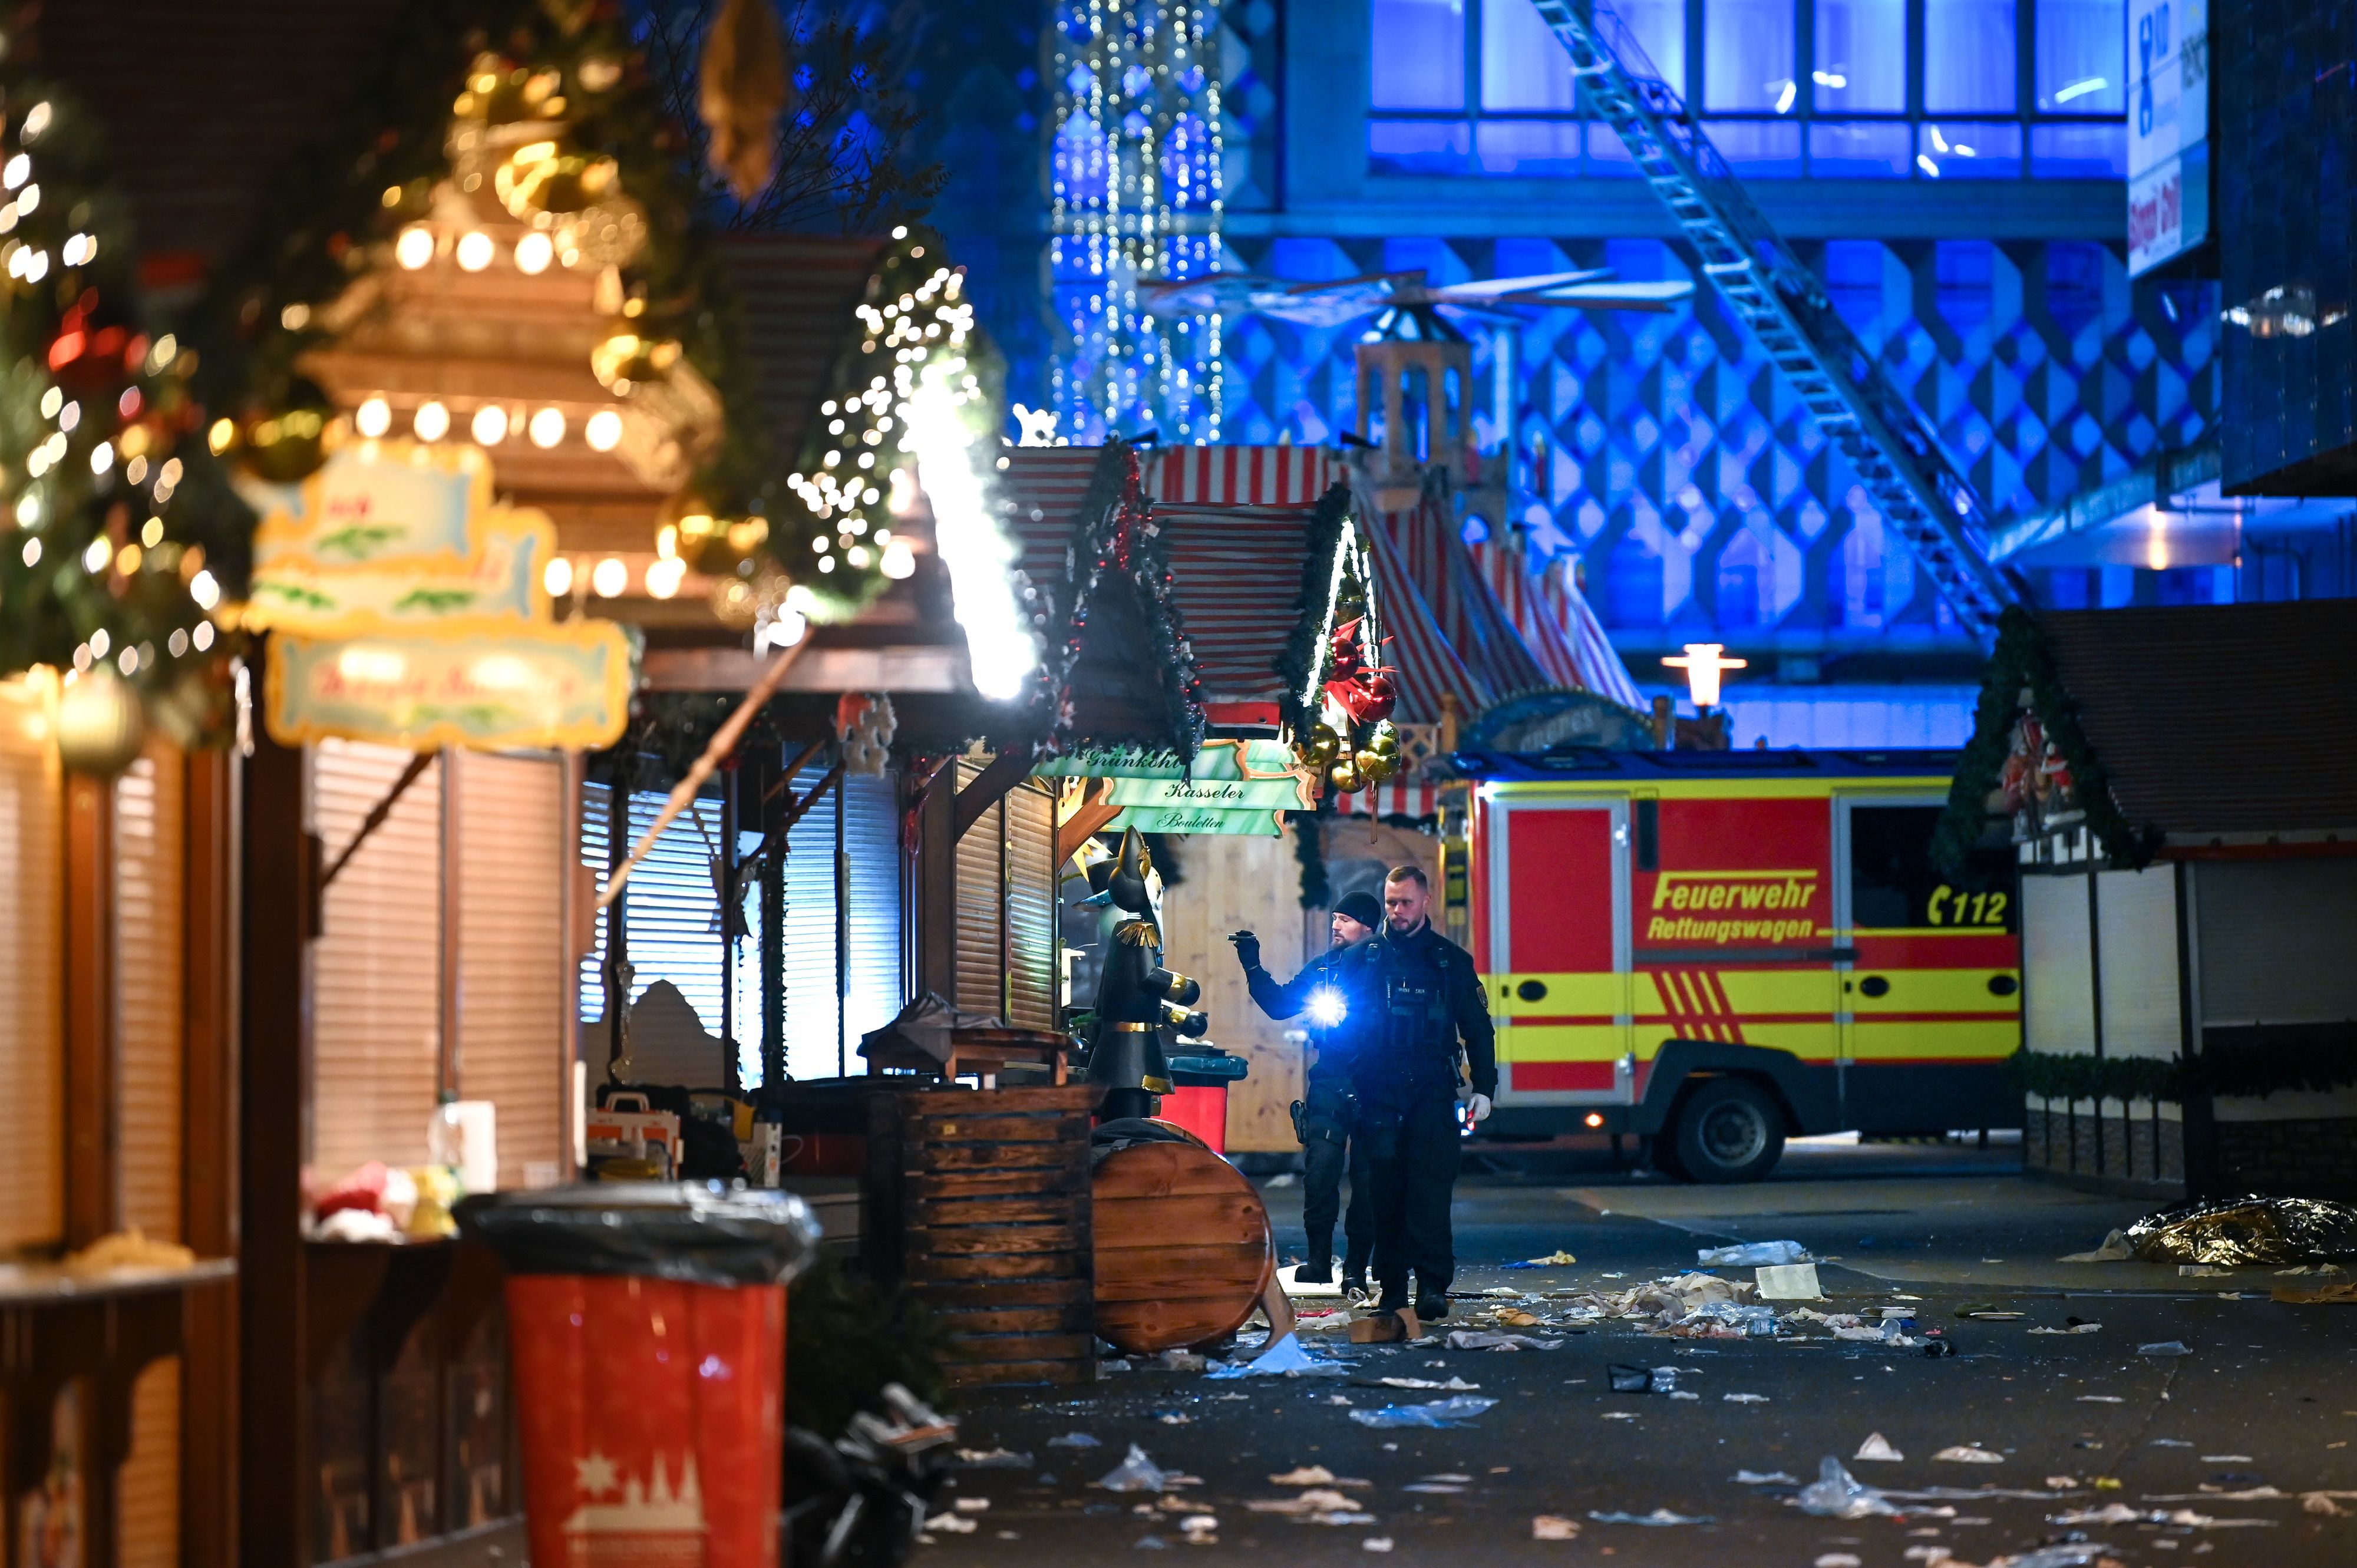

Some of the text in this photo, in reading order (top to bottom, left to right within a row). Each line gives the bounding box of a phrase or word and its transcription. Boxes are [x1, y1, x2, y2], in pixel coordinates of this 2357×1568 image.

[1164, 783, 1245, 799] Kasseler
[1157, 812, 1224, 828] Bouletten
[1652, 869, 1818, 909] Feuerwehr
[1953, 892, 2008, 924] 112
[1647, 916, 1813, 944] Rettungswagen
